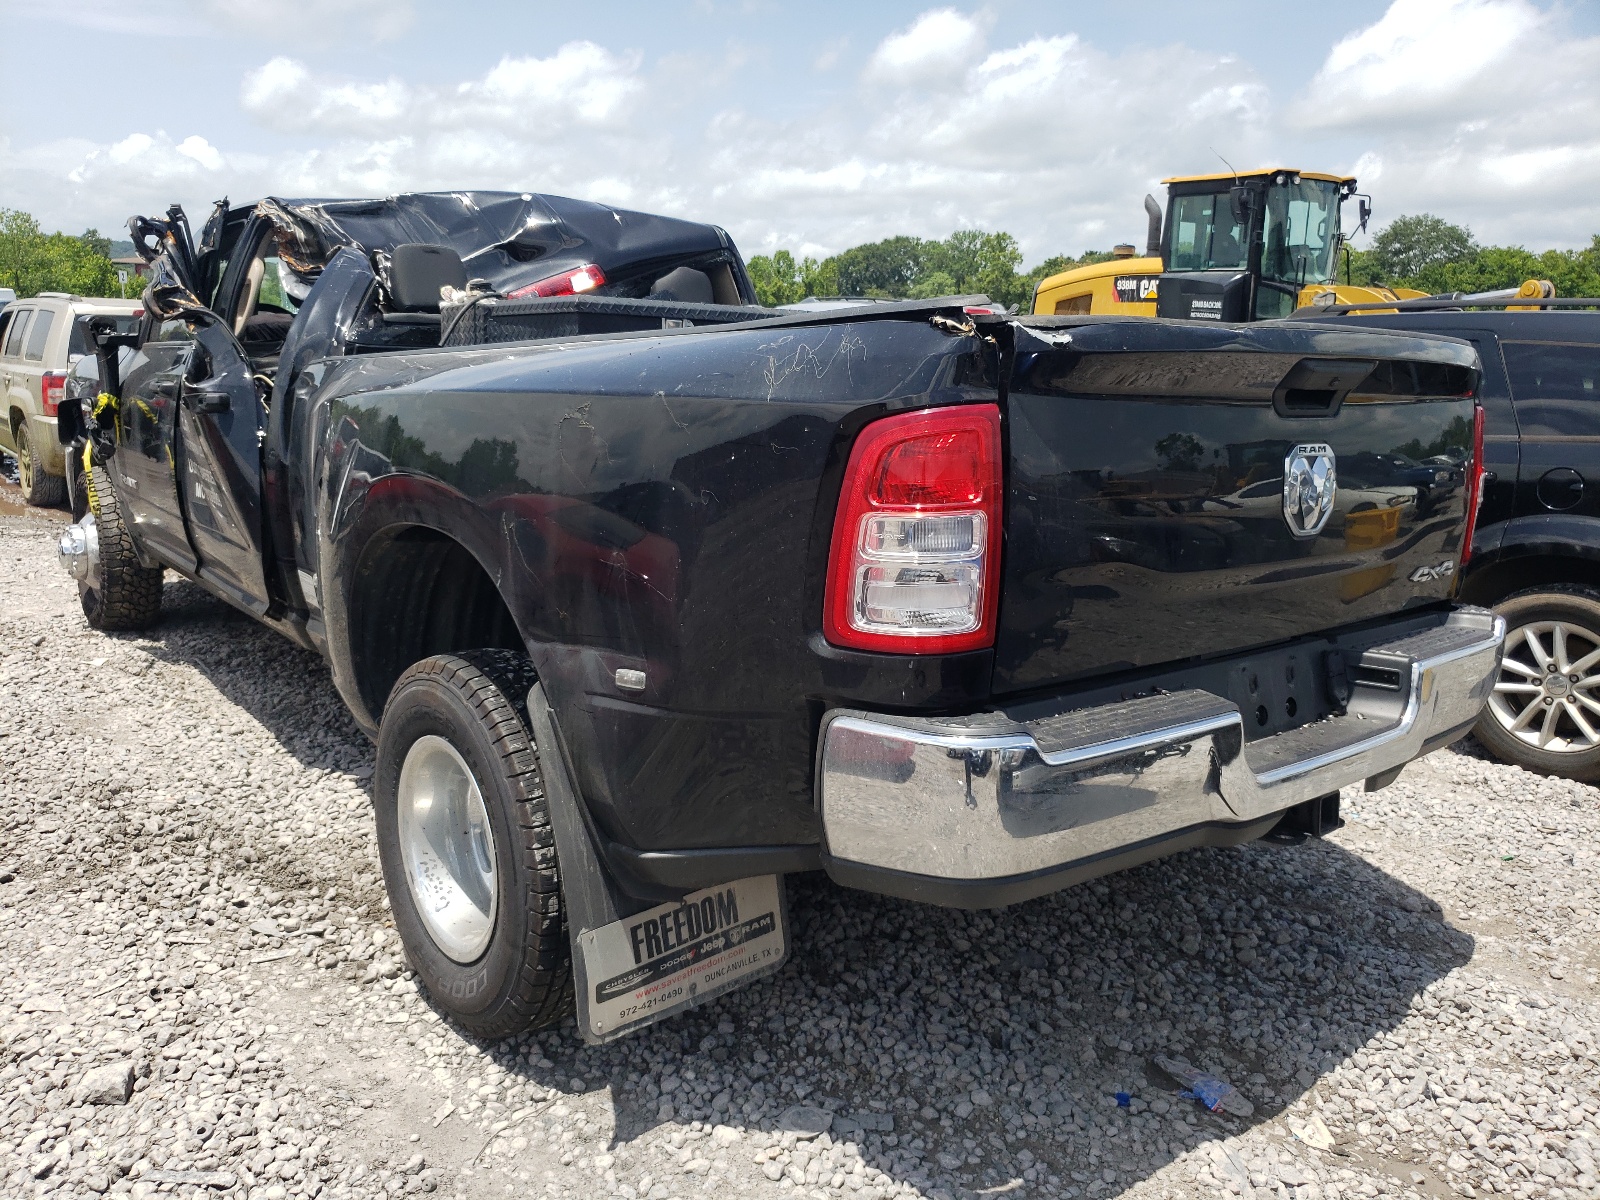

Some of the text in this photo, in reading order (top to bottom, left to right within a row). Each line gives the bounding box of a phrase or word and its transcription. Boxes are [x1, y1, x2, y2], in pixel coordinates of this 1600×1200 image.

[1117, 280, 1137, 290] 938M
[1140, 279, 1159, 298] CA
[1298, 445, 1327, 454] RAM
[630, 887, 739, 965] FREEDOM
[605, 916, 771, 990] CHRYSLER DODGE Jeep RAM
[635, 946, 746, 999] www.saveatfreedom.com
[620, 987, 683, 1019] 972-421-0490
[762, 947, 772, 959] TX
